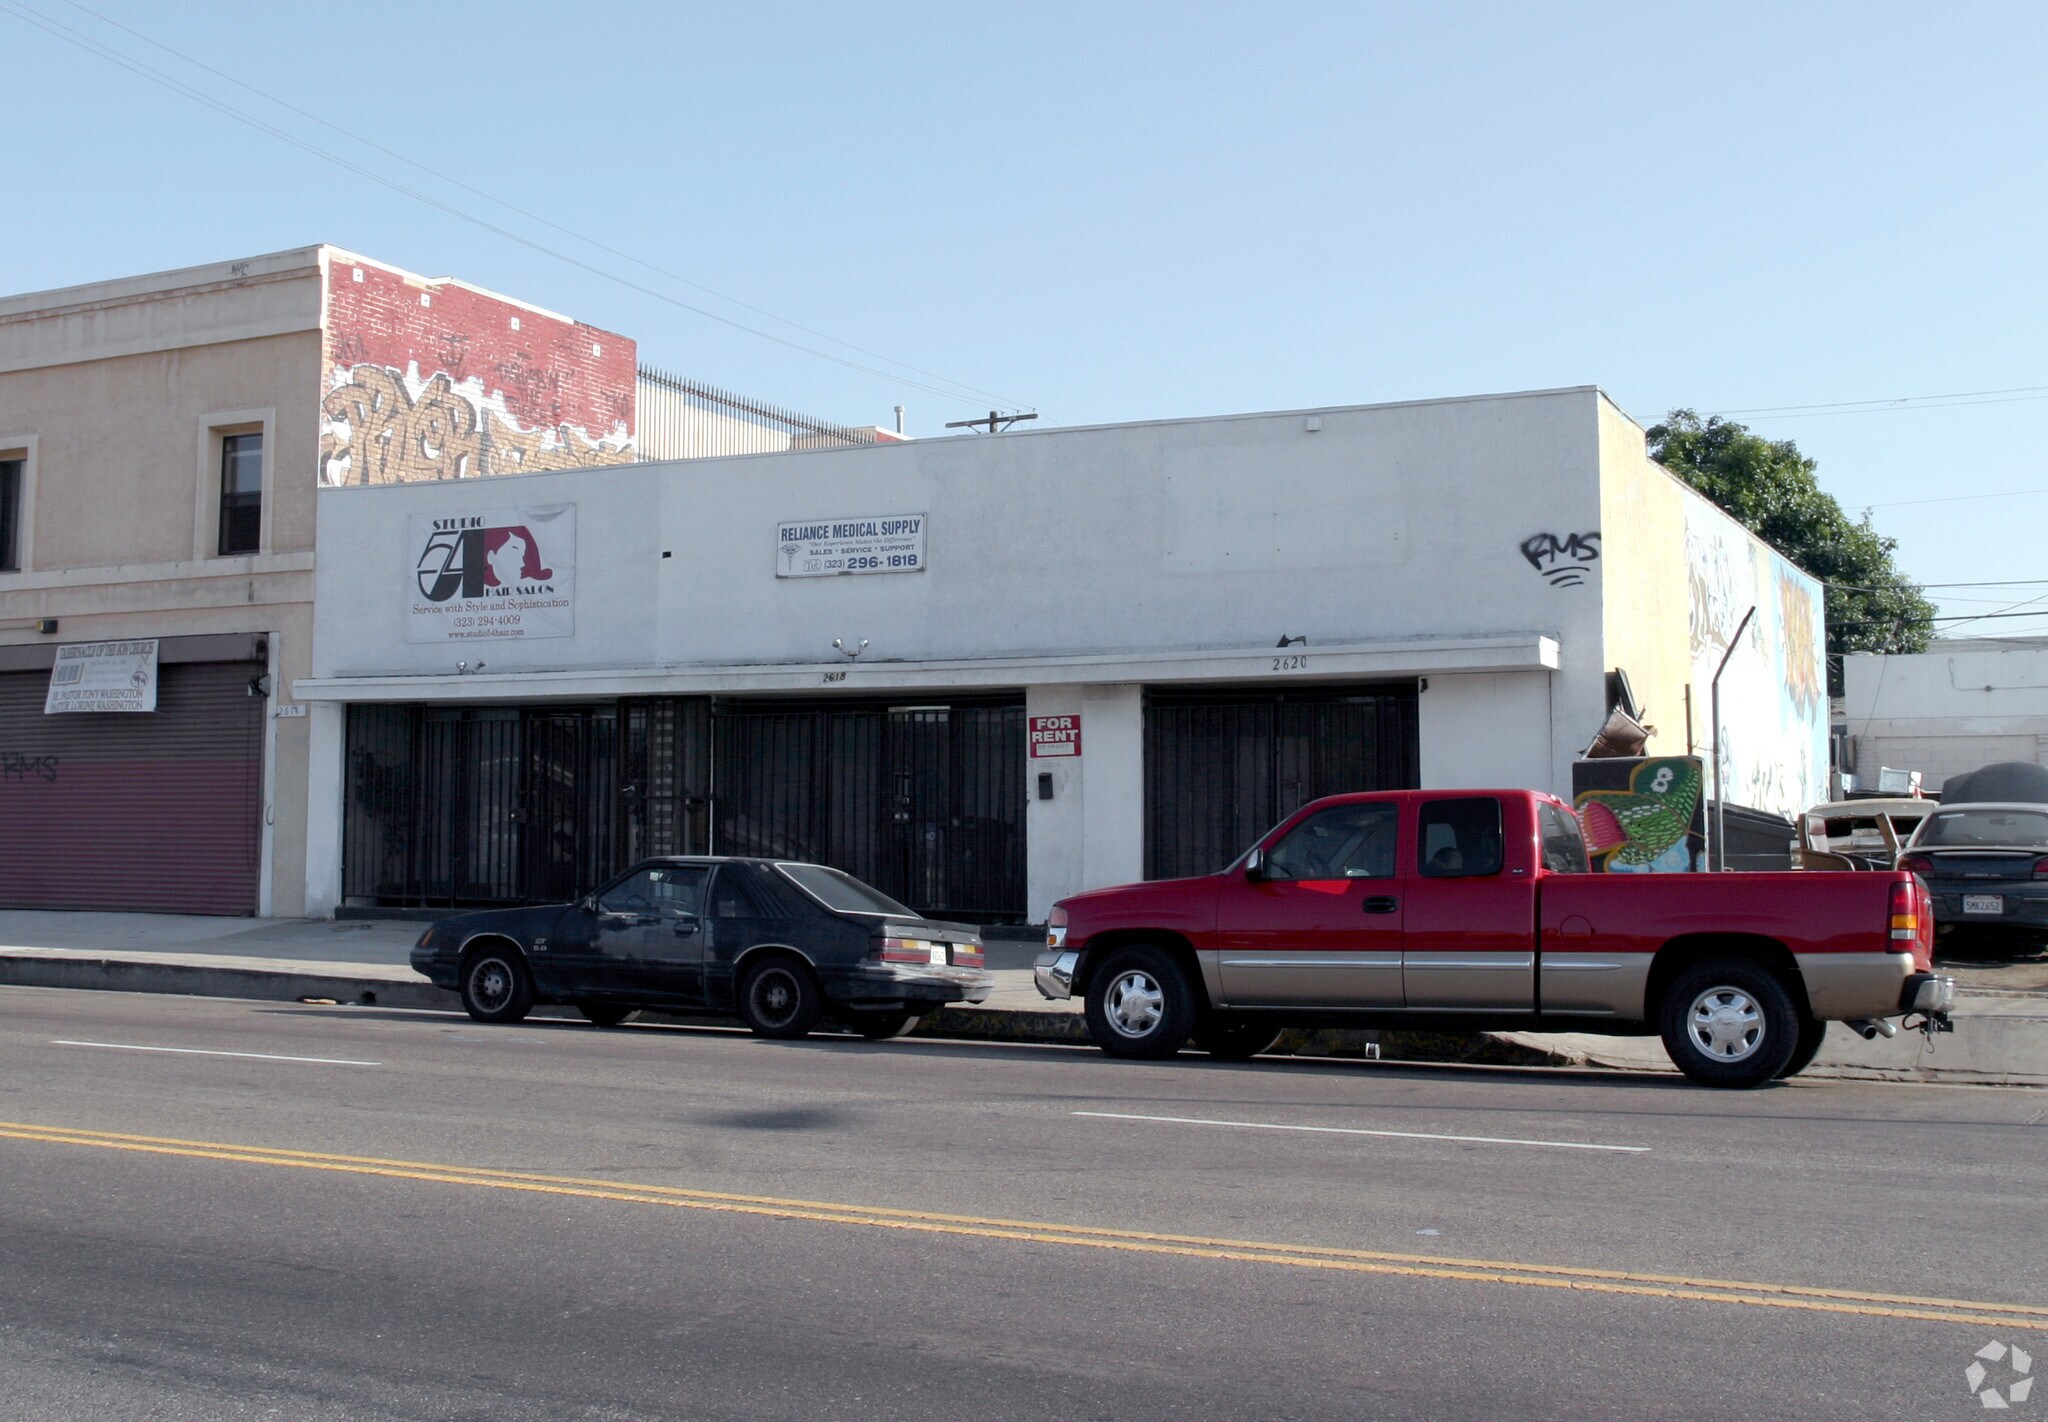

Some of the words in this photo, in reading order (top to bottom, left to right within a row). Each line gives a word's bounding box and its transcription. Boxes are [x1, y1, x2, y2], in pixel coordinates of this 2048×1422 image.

[433, 516, 485, 530] STUDIO
[781, 525, 829, 542] RELIANCE
[832, 522, 878, 539] MEDICAL
[881, 519, 921, 536] SUPPLY
[809, 548, 833, 556] SALES
[880, 544, 915, 552] SUPPORT
[416, 529, 485, 602] 54
[824, 559, 845, 570] (323)
[486, 587, 512, 597] HAIR
[516, 584, 554, 595] SALON
[413, 603, 443, 614] Service
[445, 602, 463, 613] with
[465, 600, 488, 613] Style
[489, 601, 506, 611] and
[508, 598, 569, 612] Sophistication
[453, 617, 476, 628] (323)
[448, 628, 525, 639] www.studio54hair.com
[1272, 655, 1307, 671] 2620
[823, 671, 847, 683] 2618
[1037, 718, 1072, 730] FOR
[1031, 729, 1078, 743] RENT
